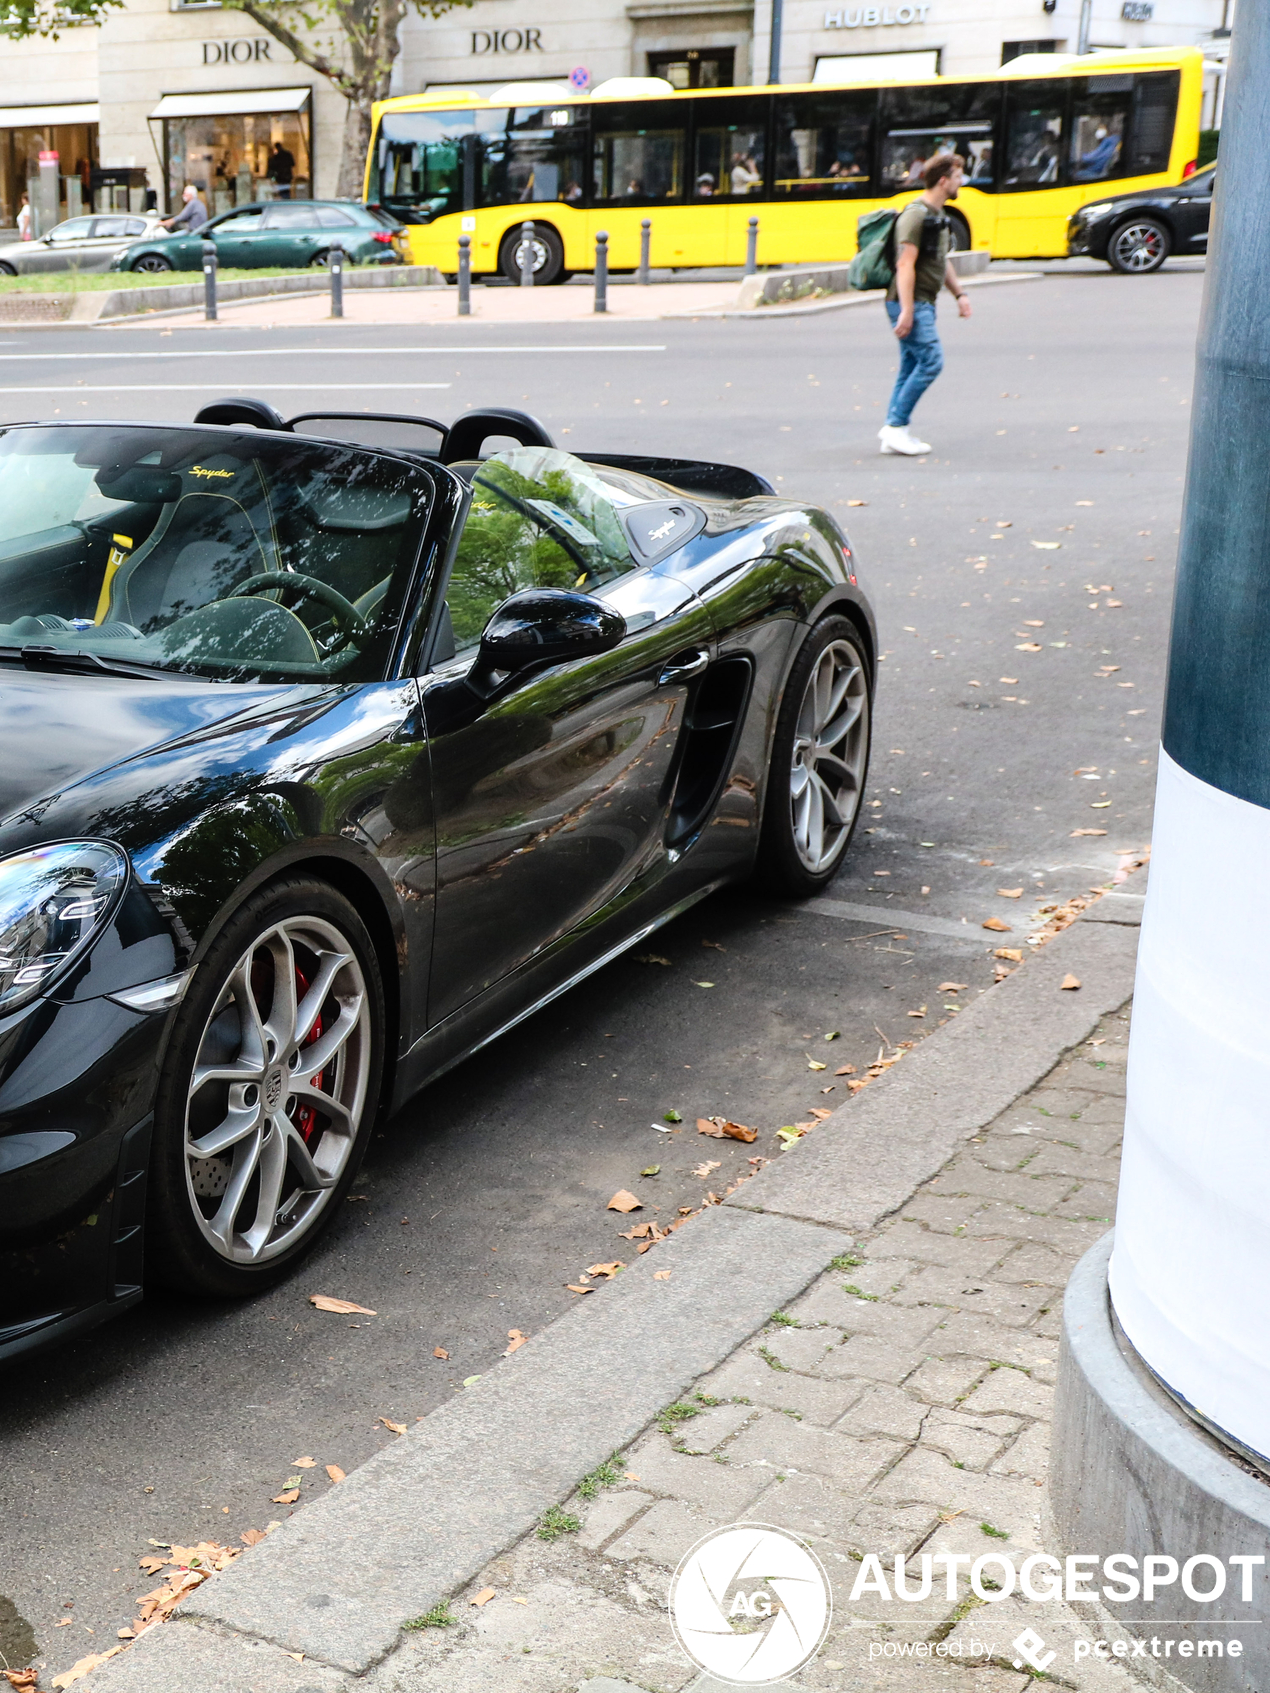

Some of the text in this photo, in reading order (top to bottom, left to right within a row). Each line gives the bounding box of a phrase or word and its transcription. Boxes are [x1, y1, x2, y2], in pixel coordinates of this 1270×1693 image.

[824, 4, 930, 30] HUBLOT
[202, 39, 272, 65] DIOR
[471, 28, 545, 54] DIOR
[188, 465, 235, 480] Spyder
